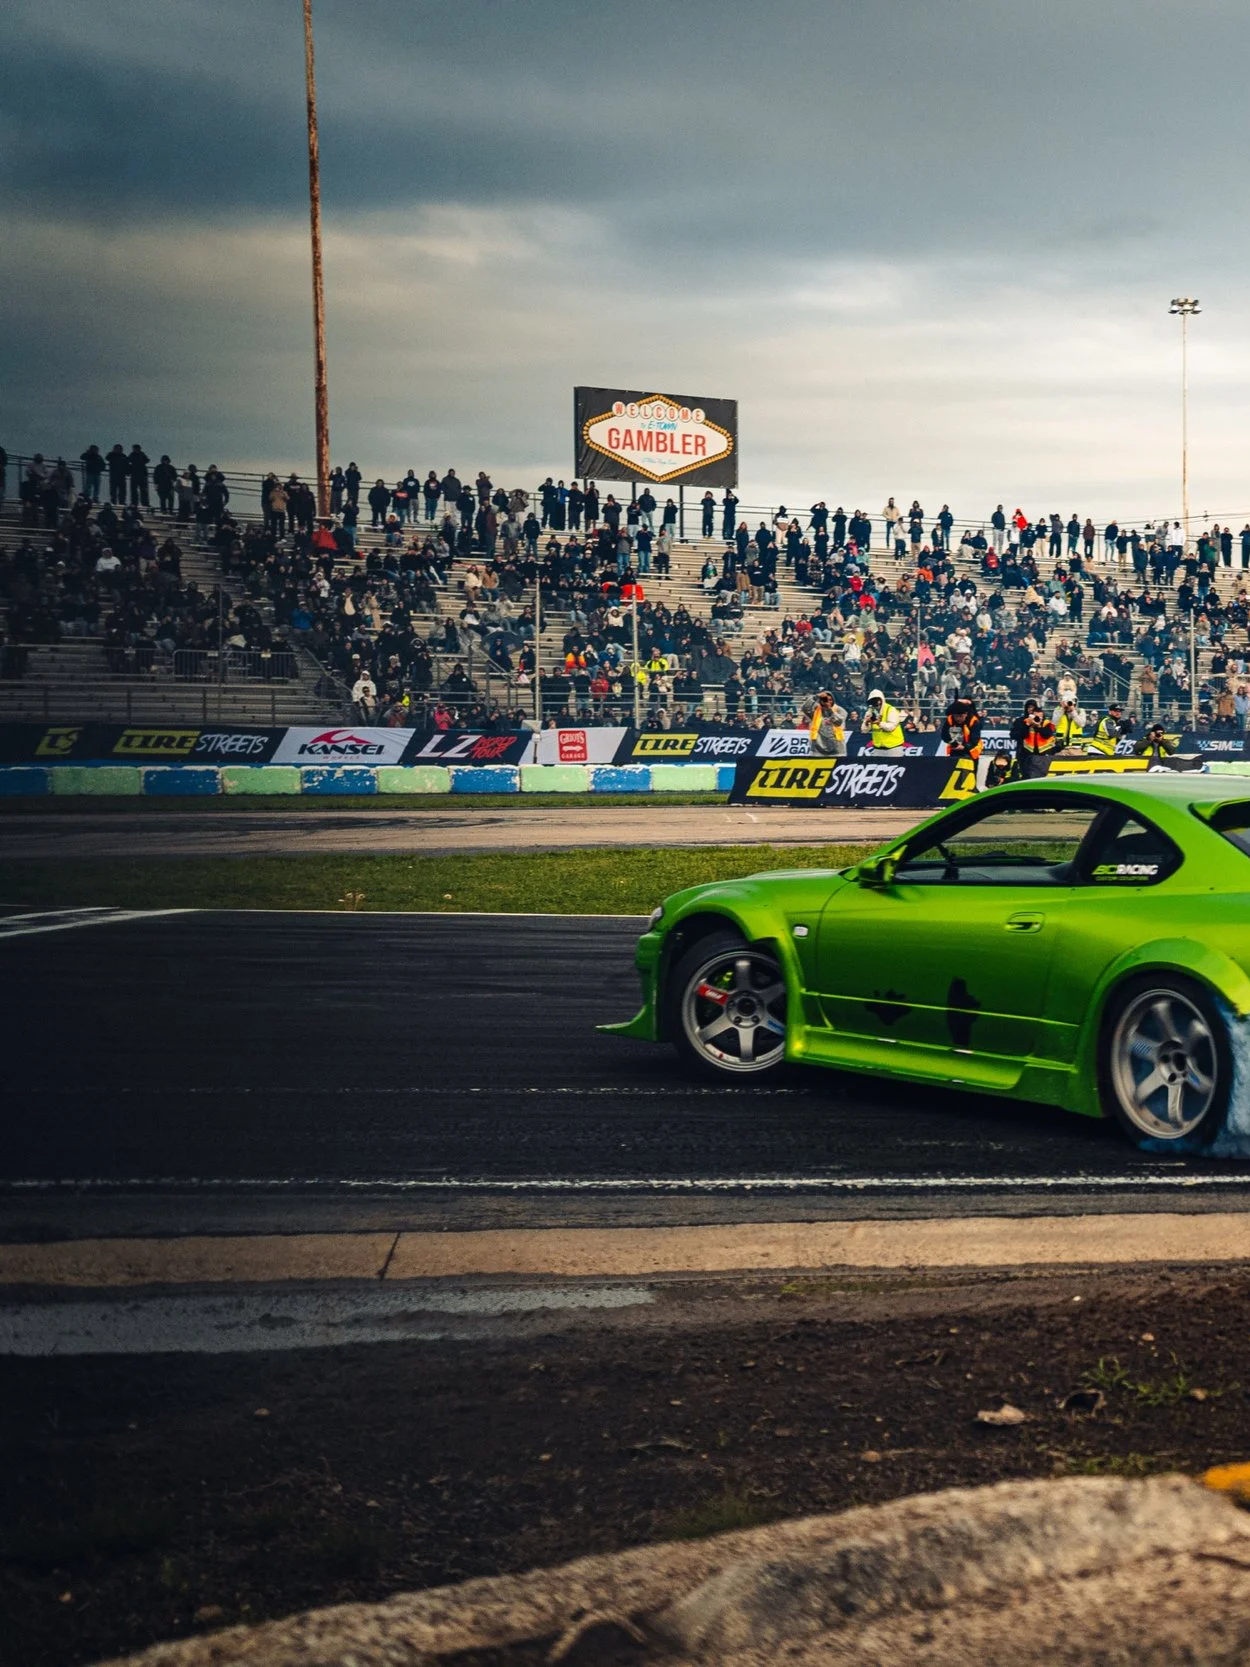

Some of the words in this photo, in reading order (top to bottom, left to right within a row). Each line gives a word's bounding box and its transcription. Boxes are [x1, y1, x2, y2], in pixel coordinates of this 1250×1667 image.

[615, 403, 702, 422] WELCOME
[608, 428, 706, 456] GAMBLER
[121, 734, 199, 750] TIRE
[195, 733, 269, 754] STREETS
[298, 743, 385, 755] KANSEI
[415, 734, 483, 758] LZ
[638, 738, 697, 751] TIRE
[694, 736, 752, 755] STREETS
[757, 767, 832, 789] TIRE
[825, 763, 906, 798] STREETS
